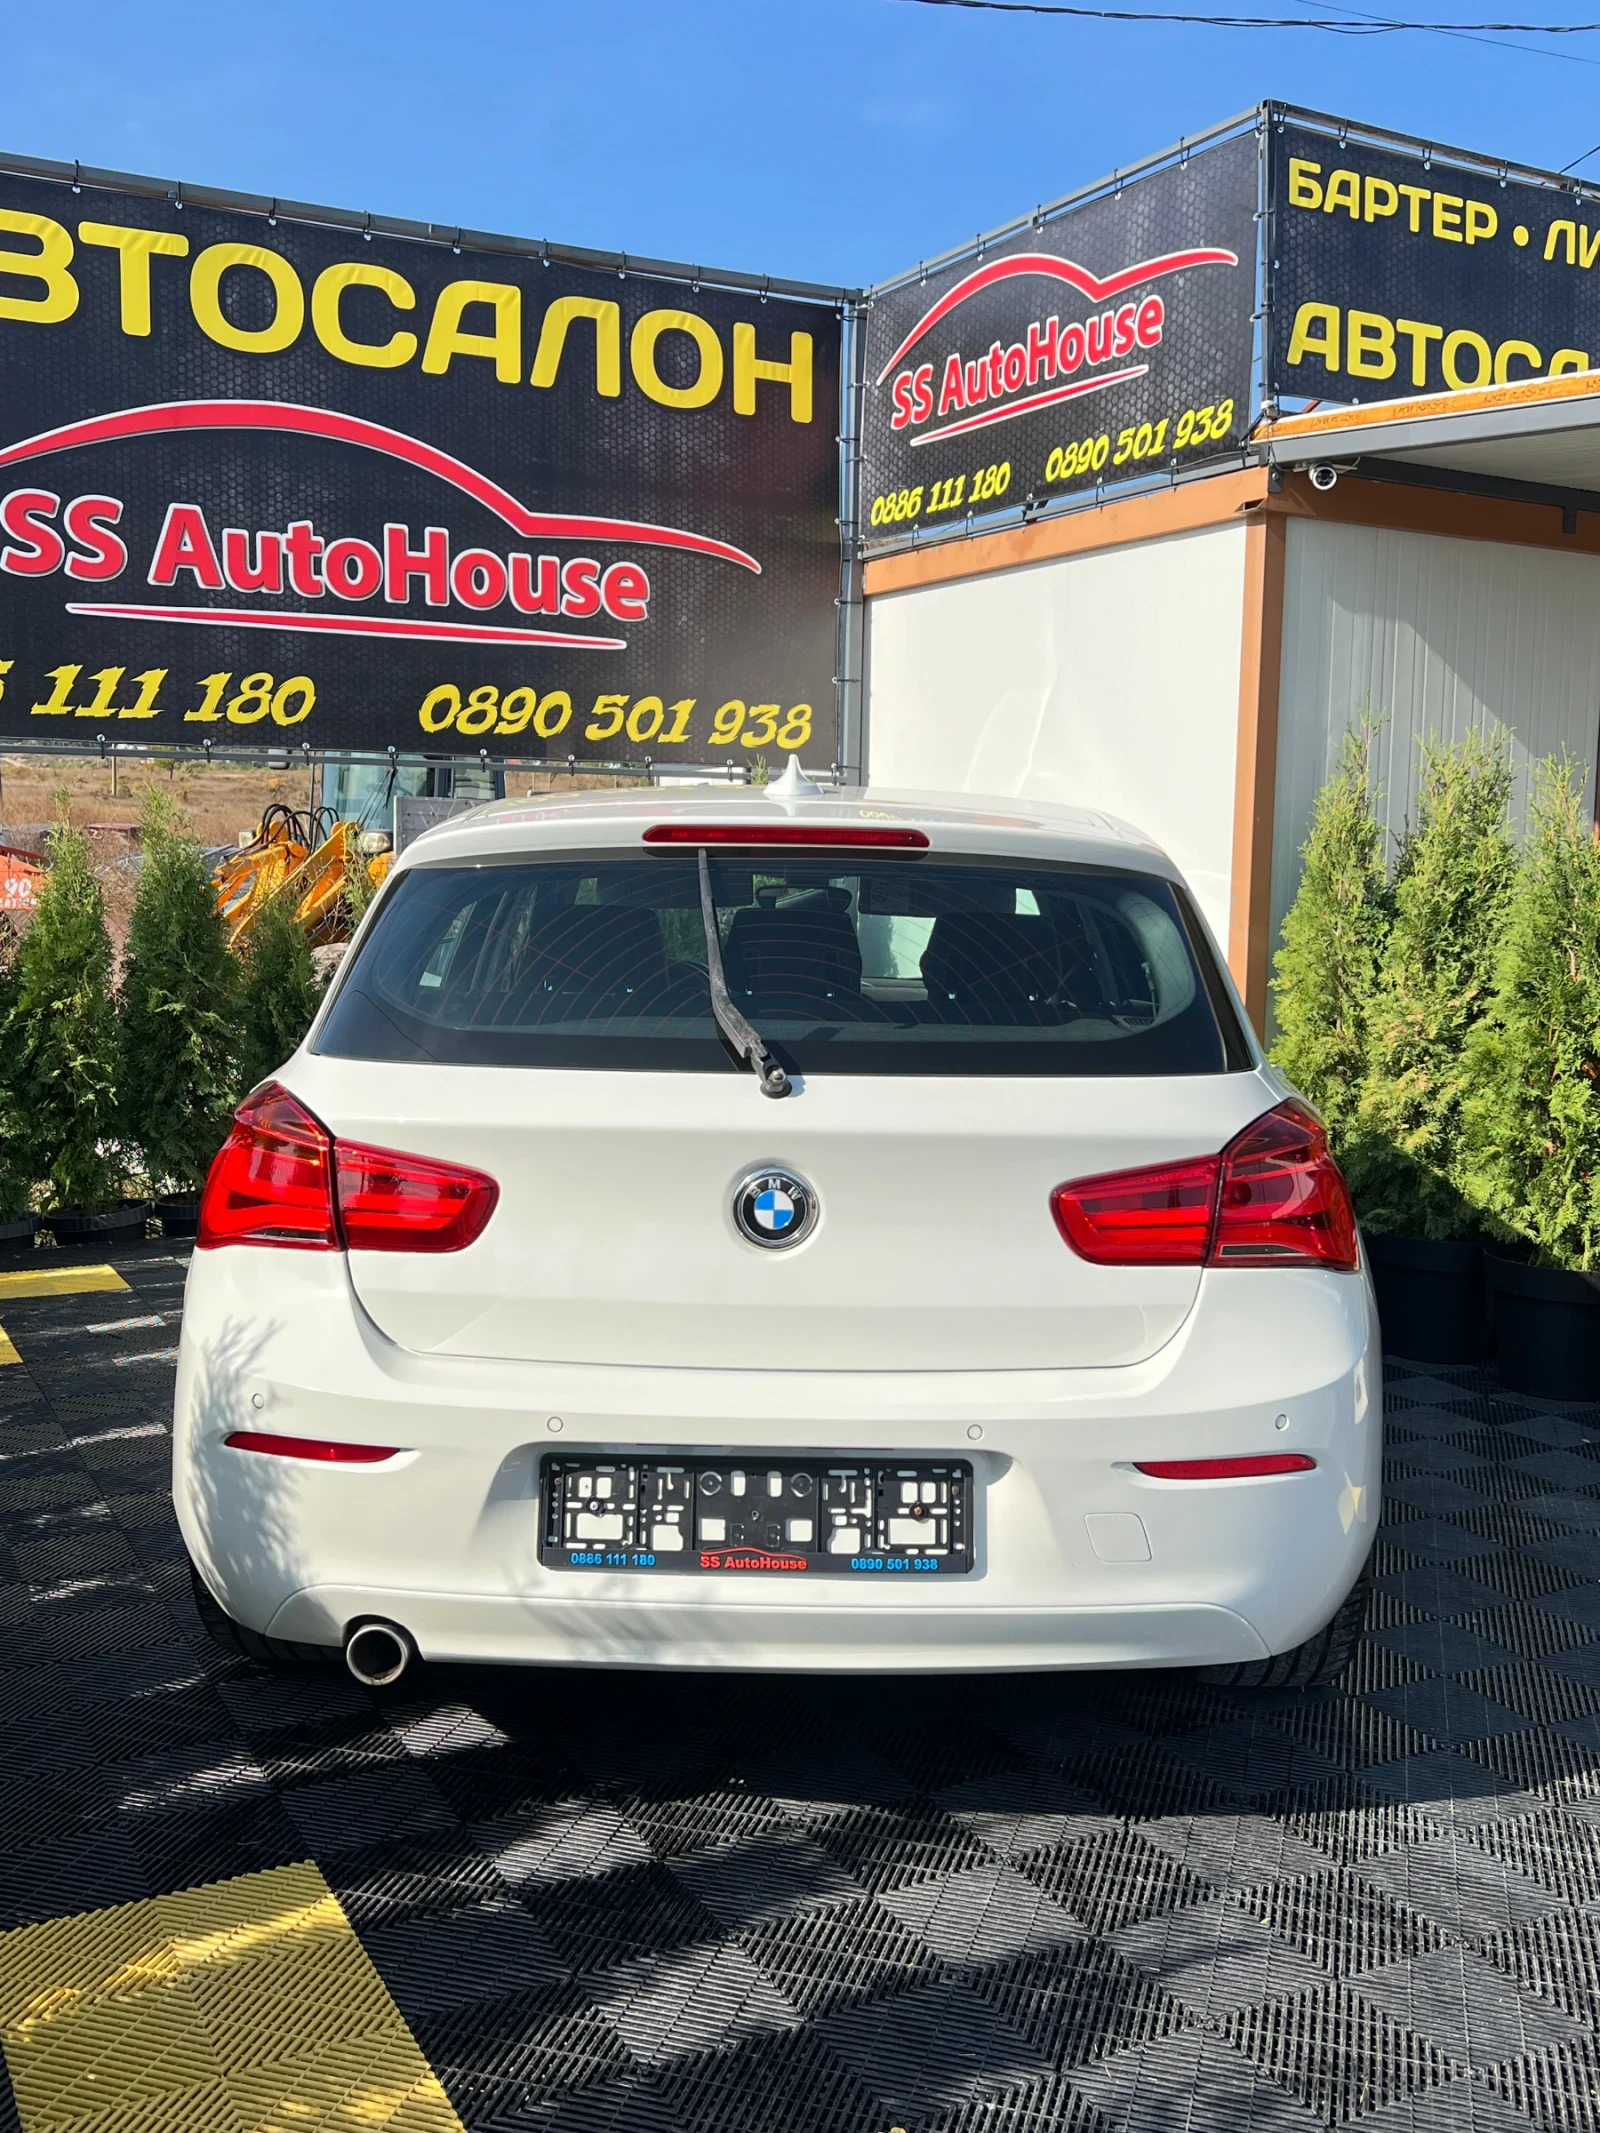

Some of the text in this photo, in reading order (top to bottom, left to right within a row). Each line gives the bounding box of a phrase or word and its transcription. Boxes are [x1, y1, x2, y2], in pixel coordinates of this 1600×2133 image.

[1288, 157, 1498, 245] БАРТЕР
[890, 294, 1165, 430] SS AutoHouse
[1045, 398, 1234, 483] 0890 501 938
[870, 461, 1011, 527] 0886 111 180
[1, 488, 651, 621] SS AutoHouse
[30, 663, 169, 719] 111
[183, 671, 317, 727] 180
[418, 683, 812, 749] 0890 501 938
[748, 1178, 802, 1200] BMW
[571, 1552, 656, 1567] 0886 111 180
[700, 1555, 807, 1570] SS AutoHouse
[851, 1557, 938, 1571] 0890 501 938
